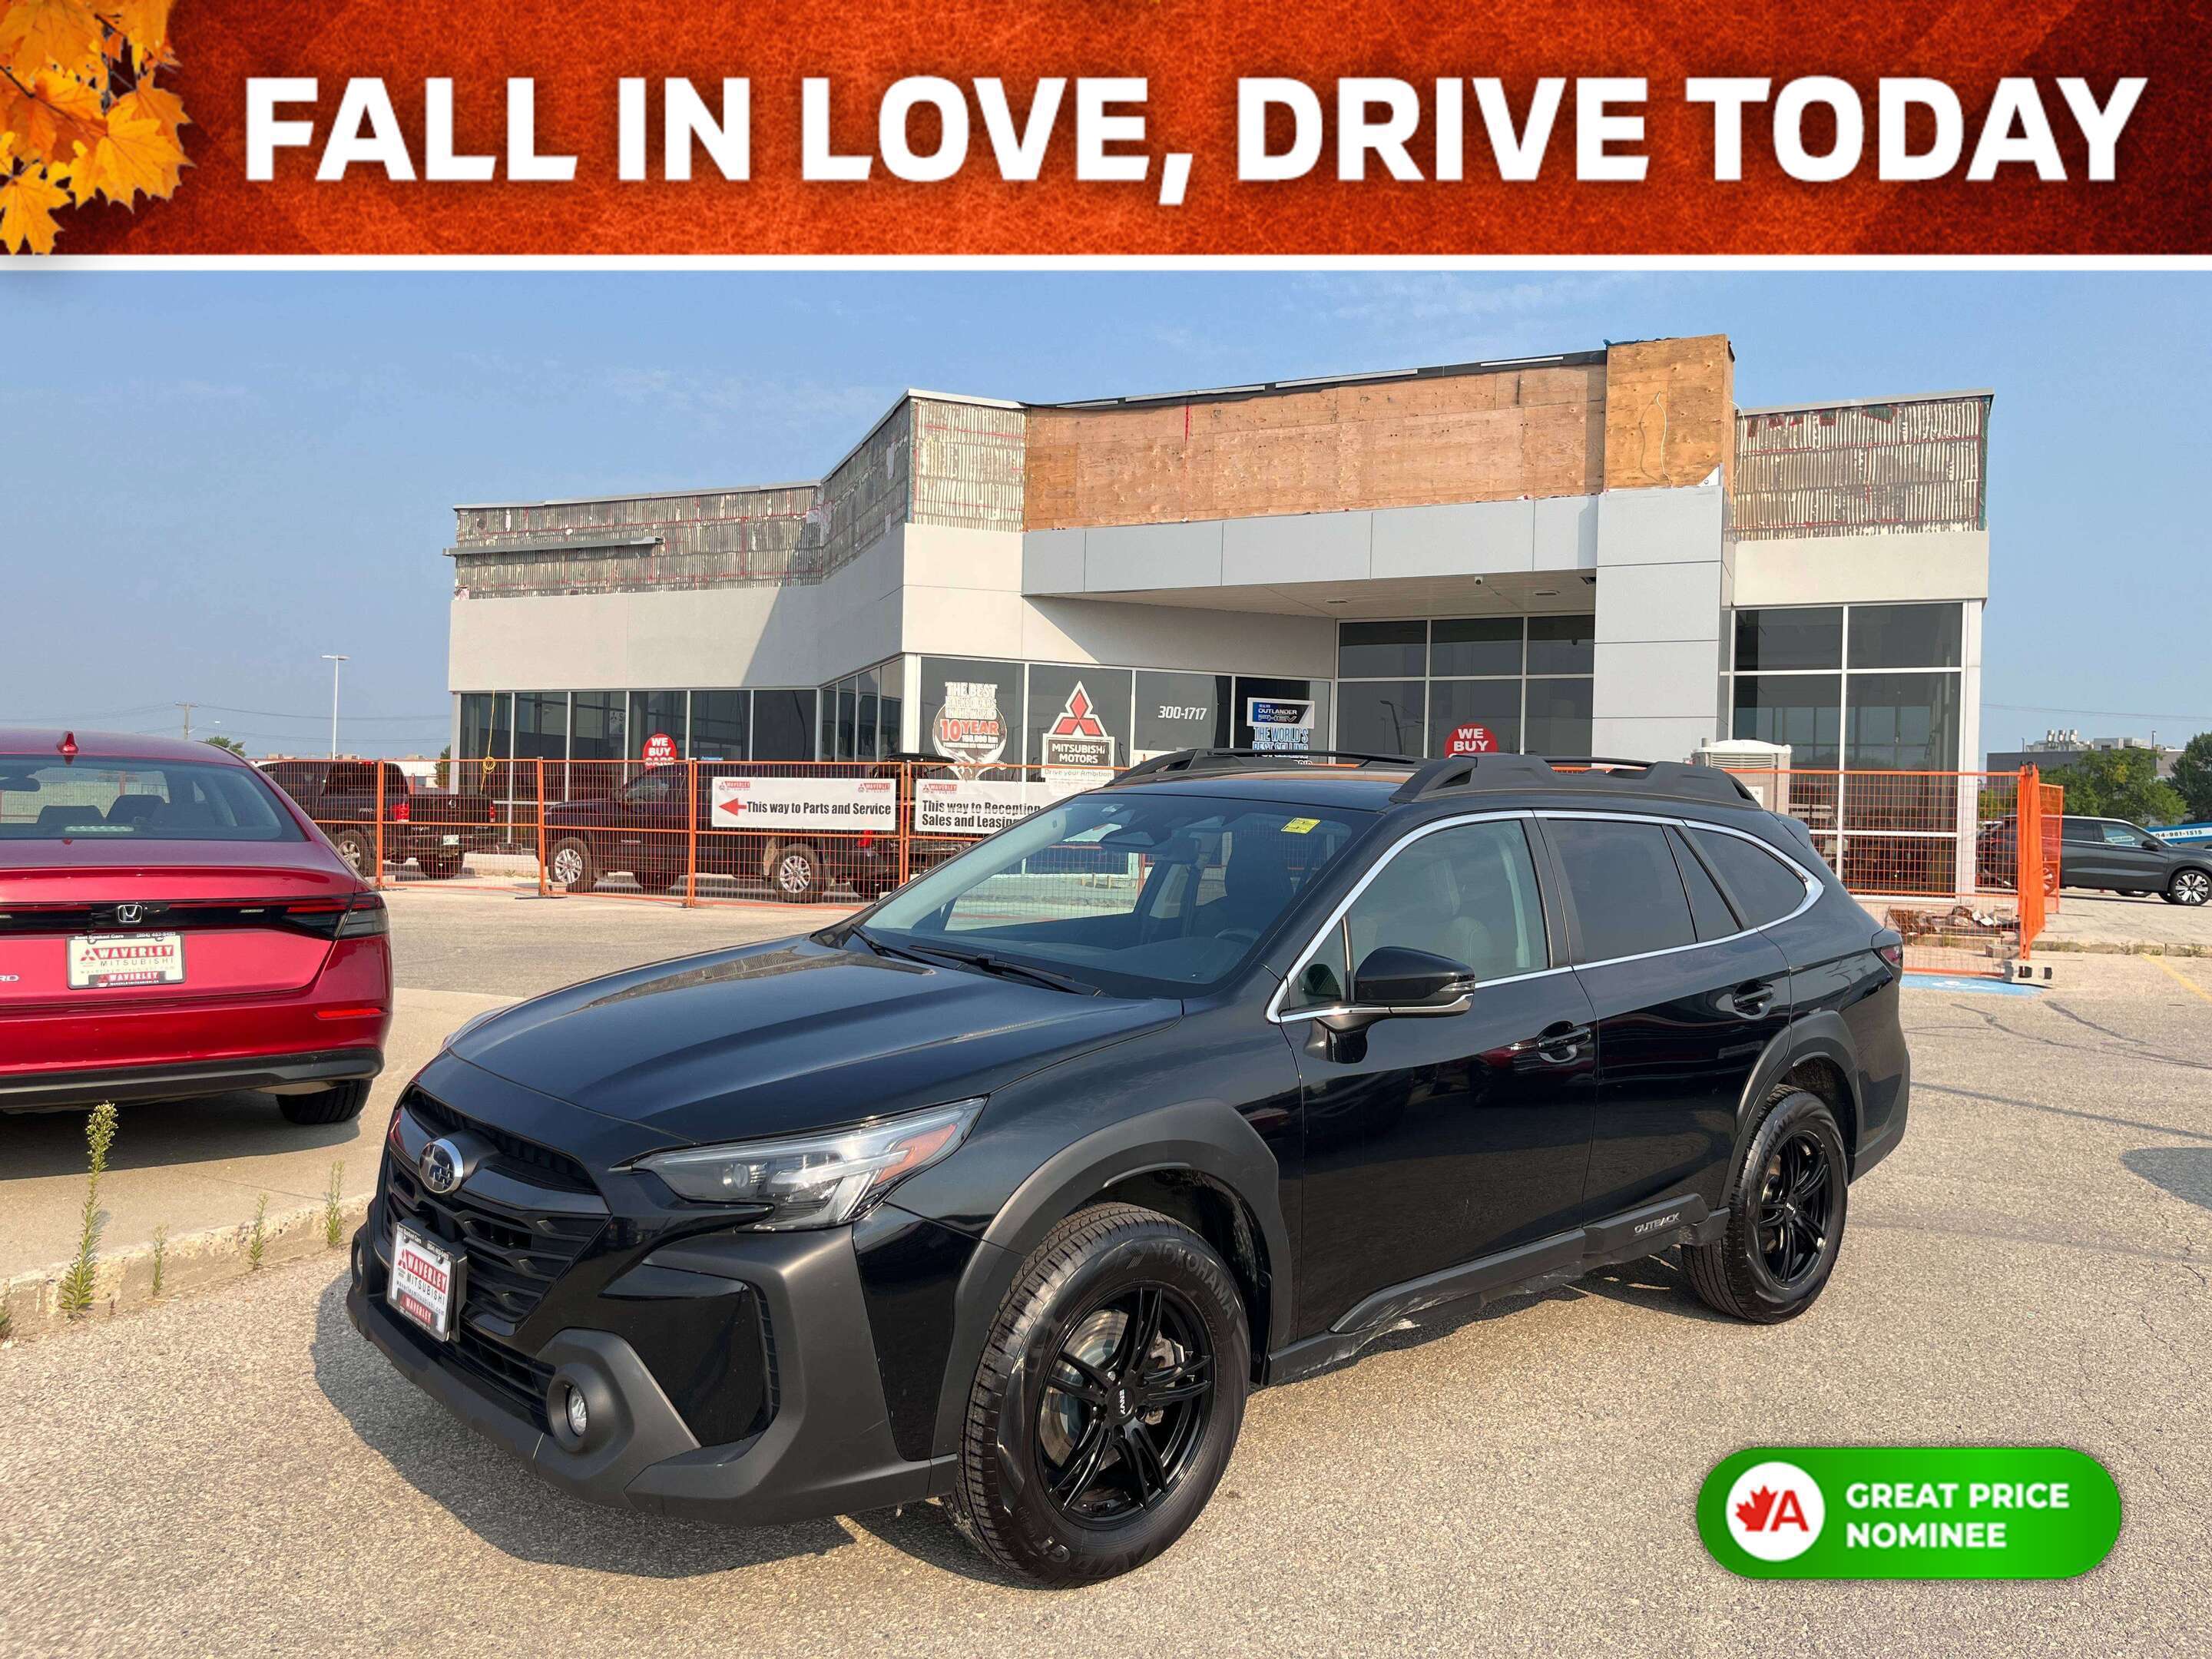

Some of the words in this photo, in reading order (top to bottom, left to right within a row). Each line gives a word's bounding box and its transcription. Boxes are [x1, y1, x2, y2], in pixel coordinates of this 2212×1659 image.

[945, 682, 968, 696] THE
[969, 683, 998, 698] BEST
[1158, 706, 1207, 720] 300-1717
[1258, 714, 1297, 723] PHEV
[940, 719, 962, 741] 10
[960, 720, 999, 735] YEAR
[1253, 727, 1270, 741] THE
[1271, 727, 1309, 743] WORLD'S
[1458, 728, 1484, 739] WE
[651, 737, 668, 747] WE
[1051, 743, 1106, 754] MITSUBISHI
[1453, 740, 1488, 752] BUY
[648, 747, 671, 757] BUY
[1059, 753, 1098, 763] MOTORS
[747, 801, 767, 813] This
[770, 803, 789, 815] way
[791, 803, 800, 813] to
[803, 803, 830, 814] Parts
[832, 803, 850, 815] and
[853, 803, 892, 815] Service
[922, 800, 945, 812] This
[947, 803, 969, 814] way
[971, 802, 982, 813] to
[922, 813, 952, 826] Sales
[955, 815, 975, 827] and
[98, 945, 173, 959] WAVERLEY
[101, 958, 174, 967] MITSUBISHI
[110, 972, 158, 981] WAVERLEY
[1634, 1212, 1681, 1233] OUTBACK
[407, 1252, 447, 1293] WAVERLEY
[407, 1273, 445, 1306] MITSUBISHI
[406, 1296, 432, 1323] WAVERLEY
